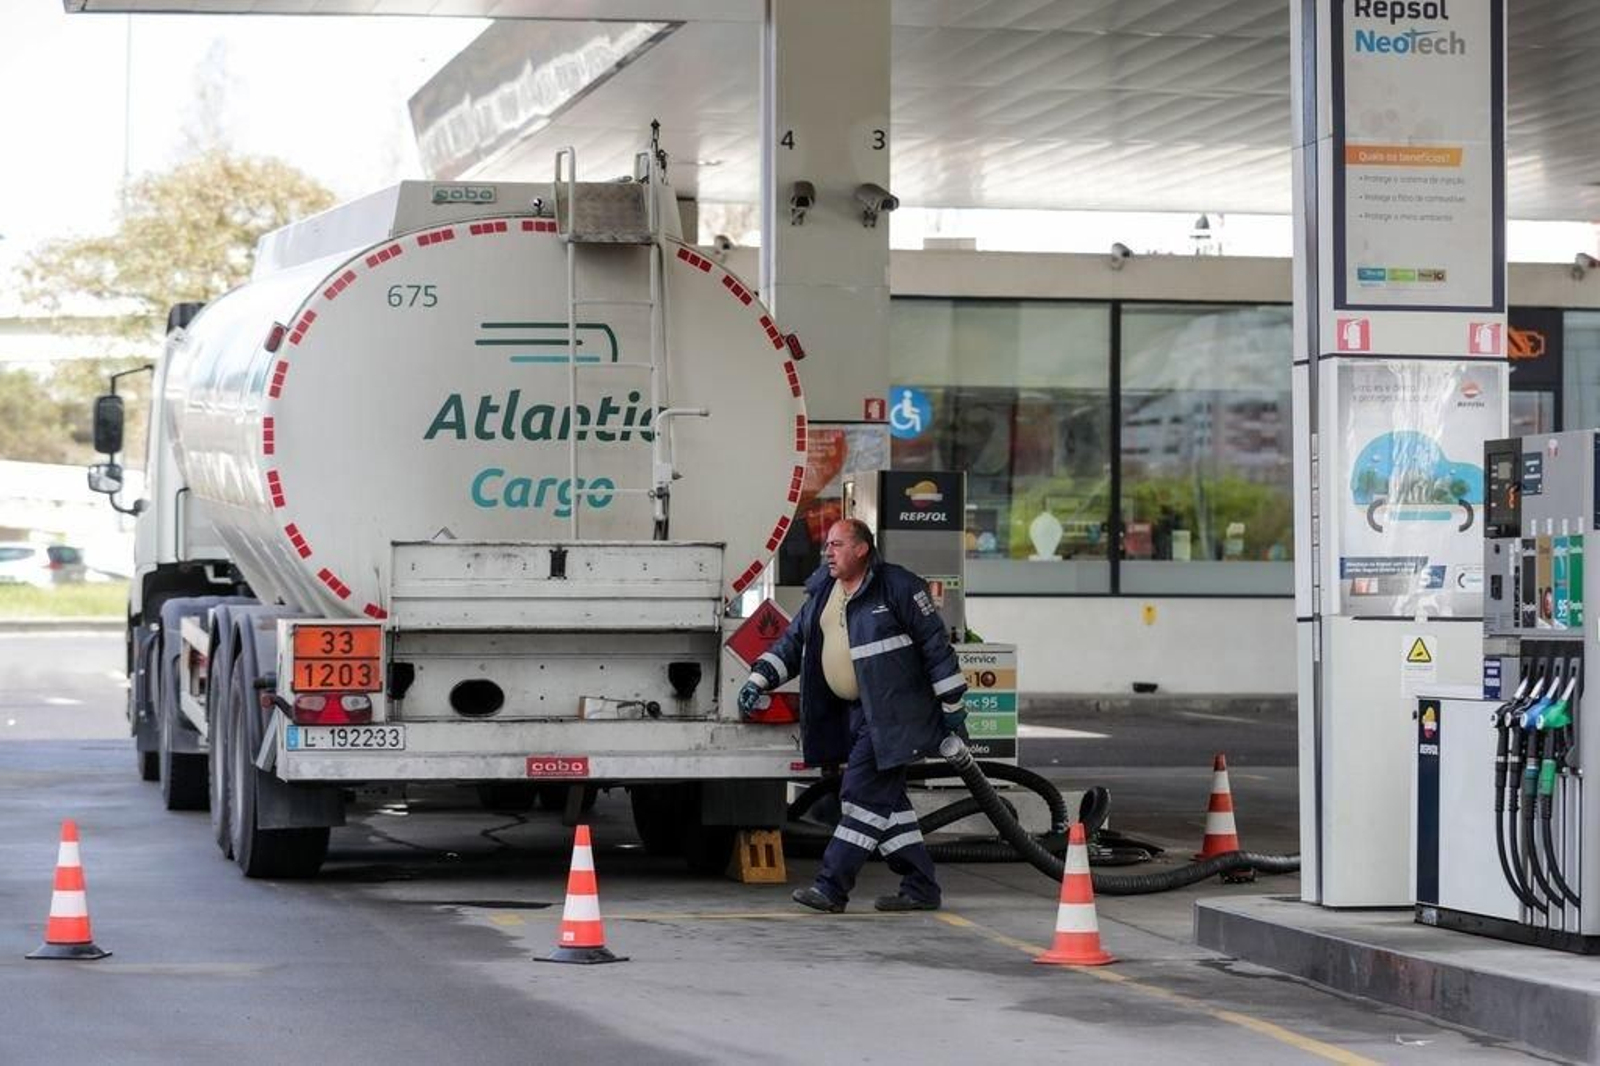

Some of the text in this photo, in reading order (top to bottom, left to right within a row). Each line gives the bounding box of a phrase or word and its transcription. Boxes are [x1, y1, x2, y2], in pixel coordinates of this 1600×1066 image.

[1354, 0, 1449, 25] Repsol
[1355, 27, 1466, 55] NeoTech
[780, 130, 795, 150] 4
[872, 130, 886, 150] 3
[387, 285, 438, 308] 675
[423, 389, 669, 442] Atlantic
[470, 467, 616, 518] Cargo
[899, 511, 948, 522] REPSOL
[320, 631, 355, 655] 33
[961, 654, 997, 664] -Service
[303, 663, 372, 688] 1203
[981, 696, 998, 709] 95
[531, 759, 584, 772] cabo
